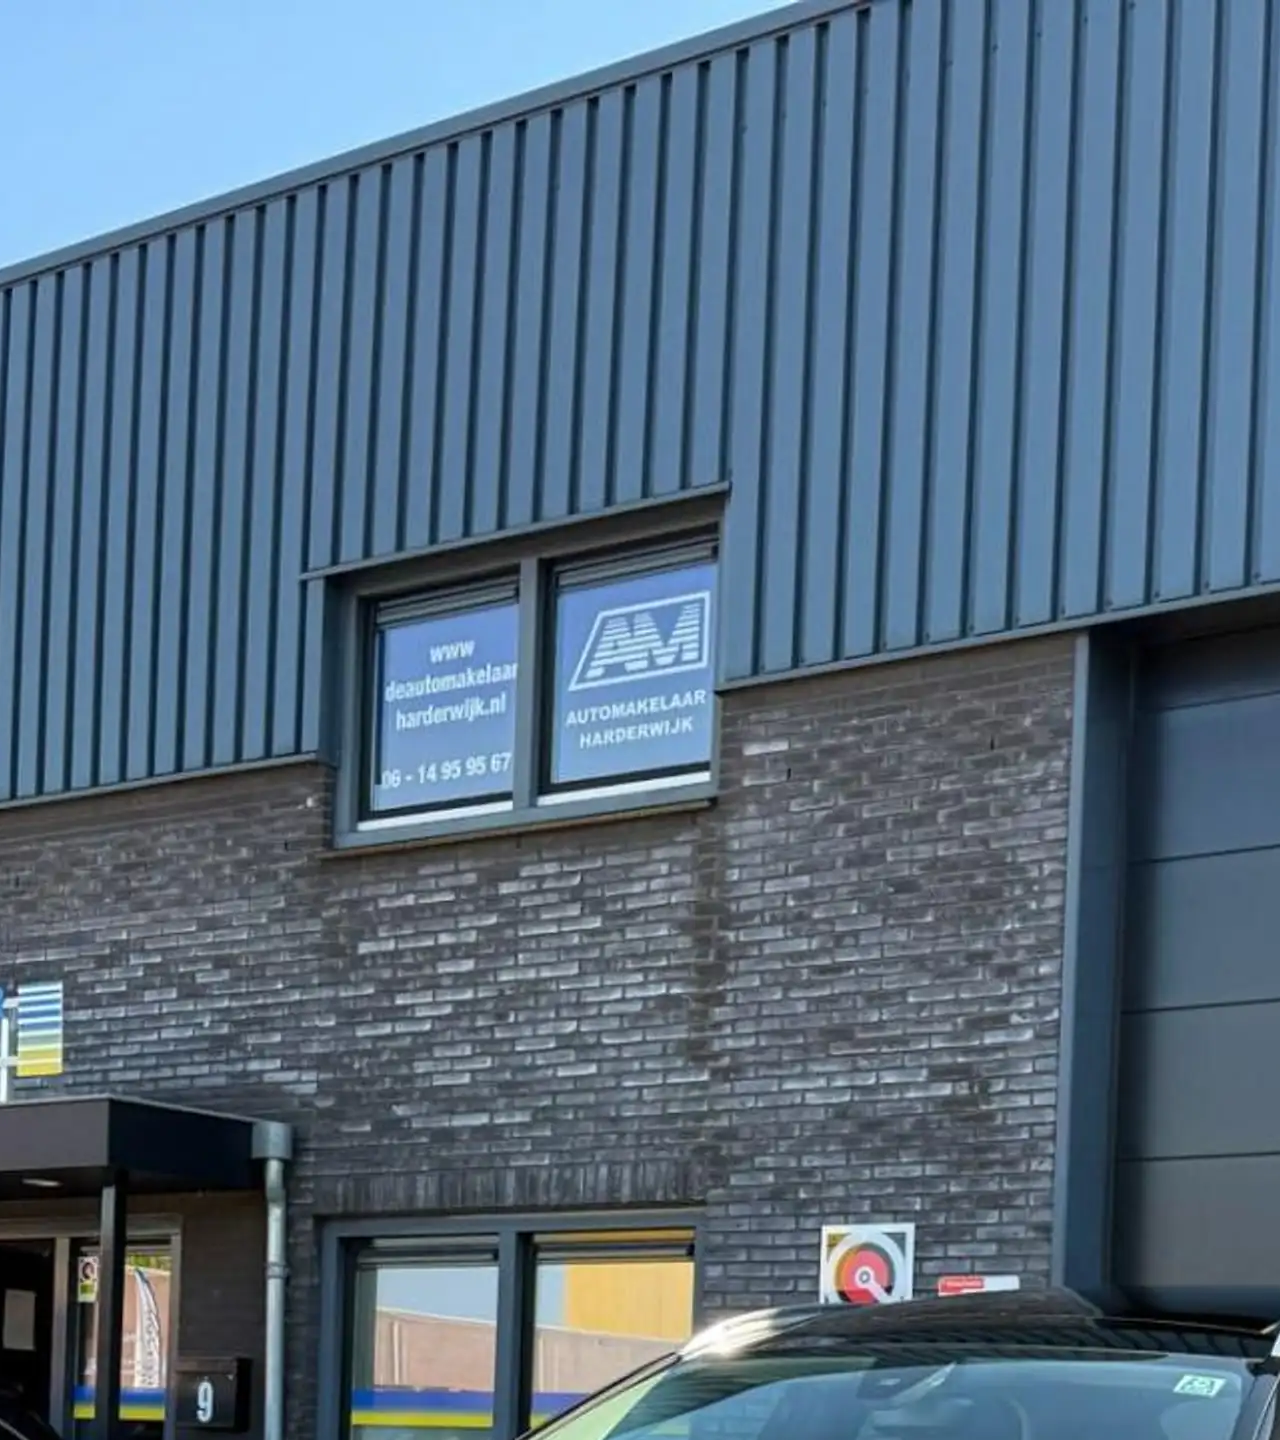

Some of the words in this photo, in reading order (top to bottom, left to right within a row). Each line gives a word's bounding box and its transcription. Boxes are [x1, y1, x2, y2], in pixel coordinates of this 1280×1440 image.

[429, 639, 475, 663] www
[396, 692, 507, 732] harderwijk.nl
[566, 689, 707, 728] AUTOMAKELAAR
[579, 716, 694, 750] HARDERWIJK
[418, 762, 437, 785] 14
[440, 758, 462, 780] 95
[465, 755, 488, 777] 95
[490, 752, 512, 774] 67
[196, 1381, 214, 1423] 9
